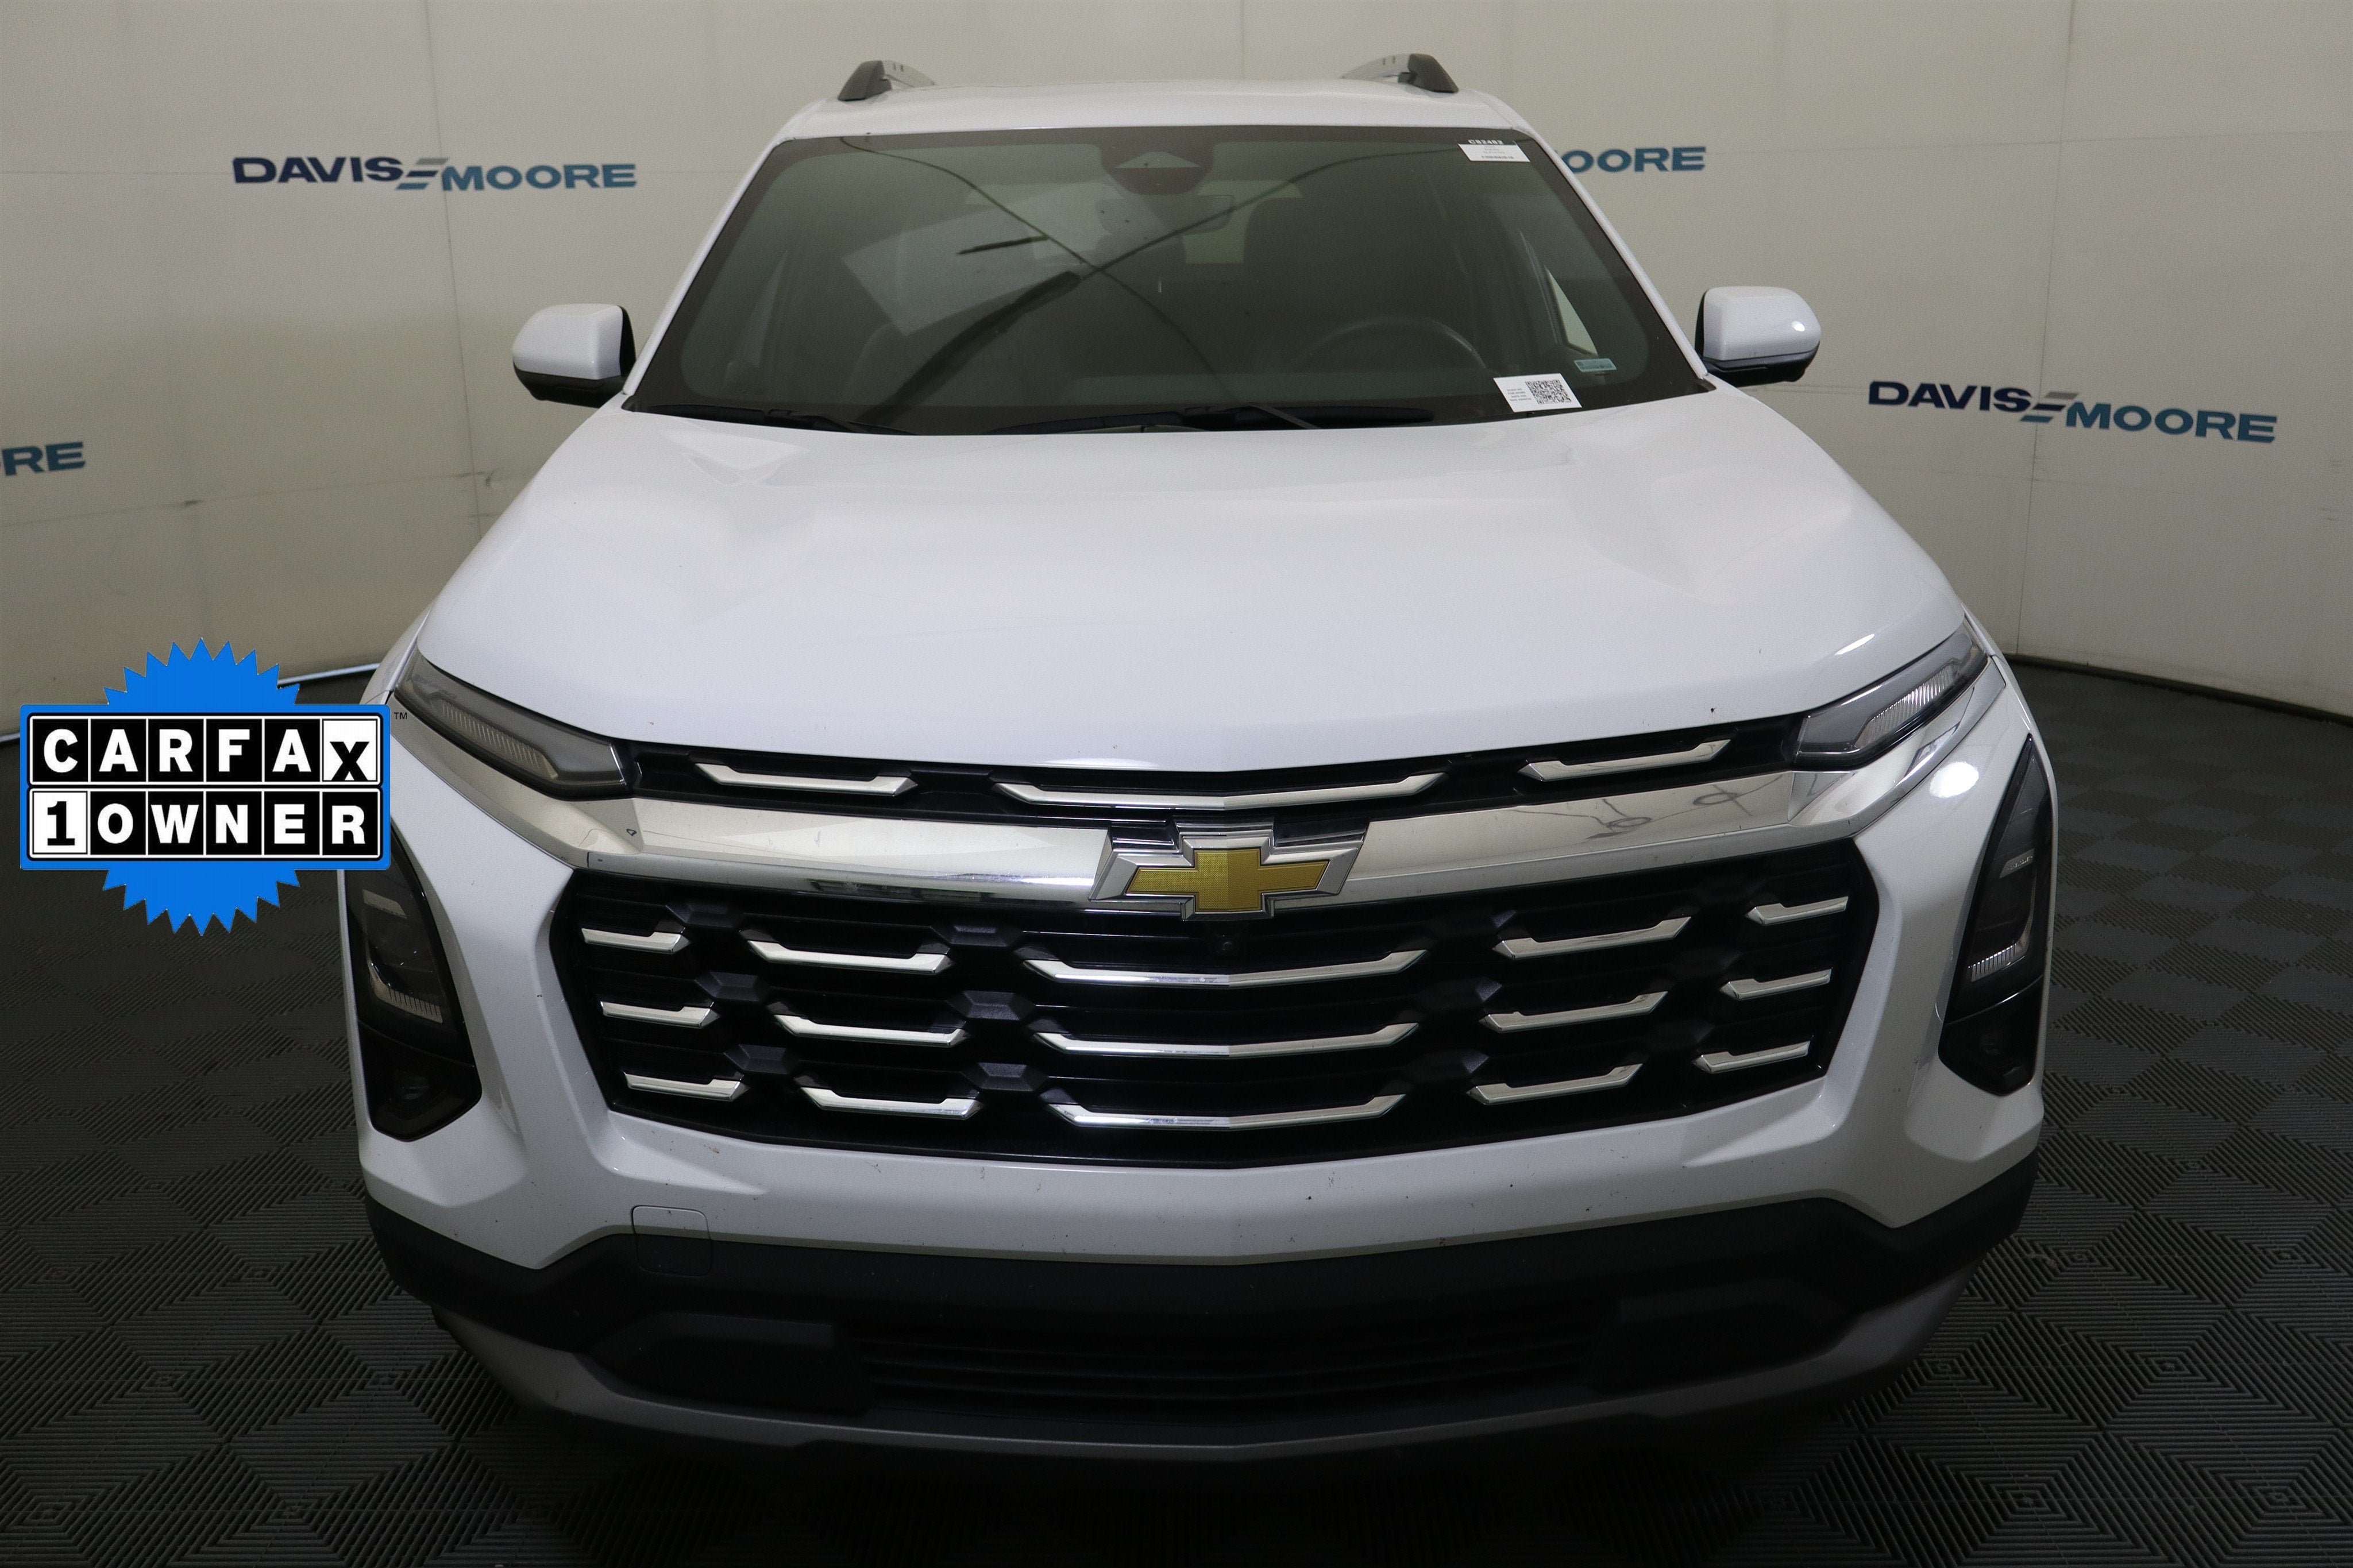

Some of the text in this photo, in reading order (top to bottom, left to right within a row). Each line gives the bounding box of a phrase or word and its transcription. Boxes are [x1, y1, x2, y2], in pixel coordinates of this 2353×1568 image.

[232, 157, 637, 191] DAVIS MOORE
[1554, 146, 1706, 173] OORE
[1868, 381, 2278, 443] DAVIS MOORE
